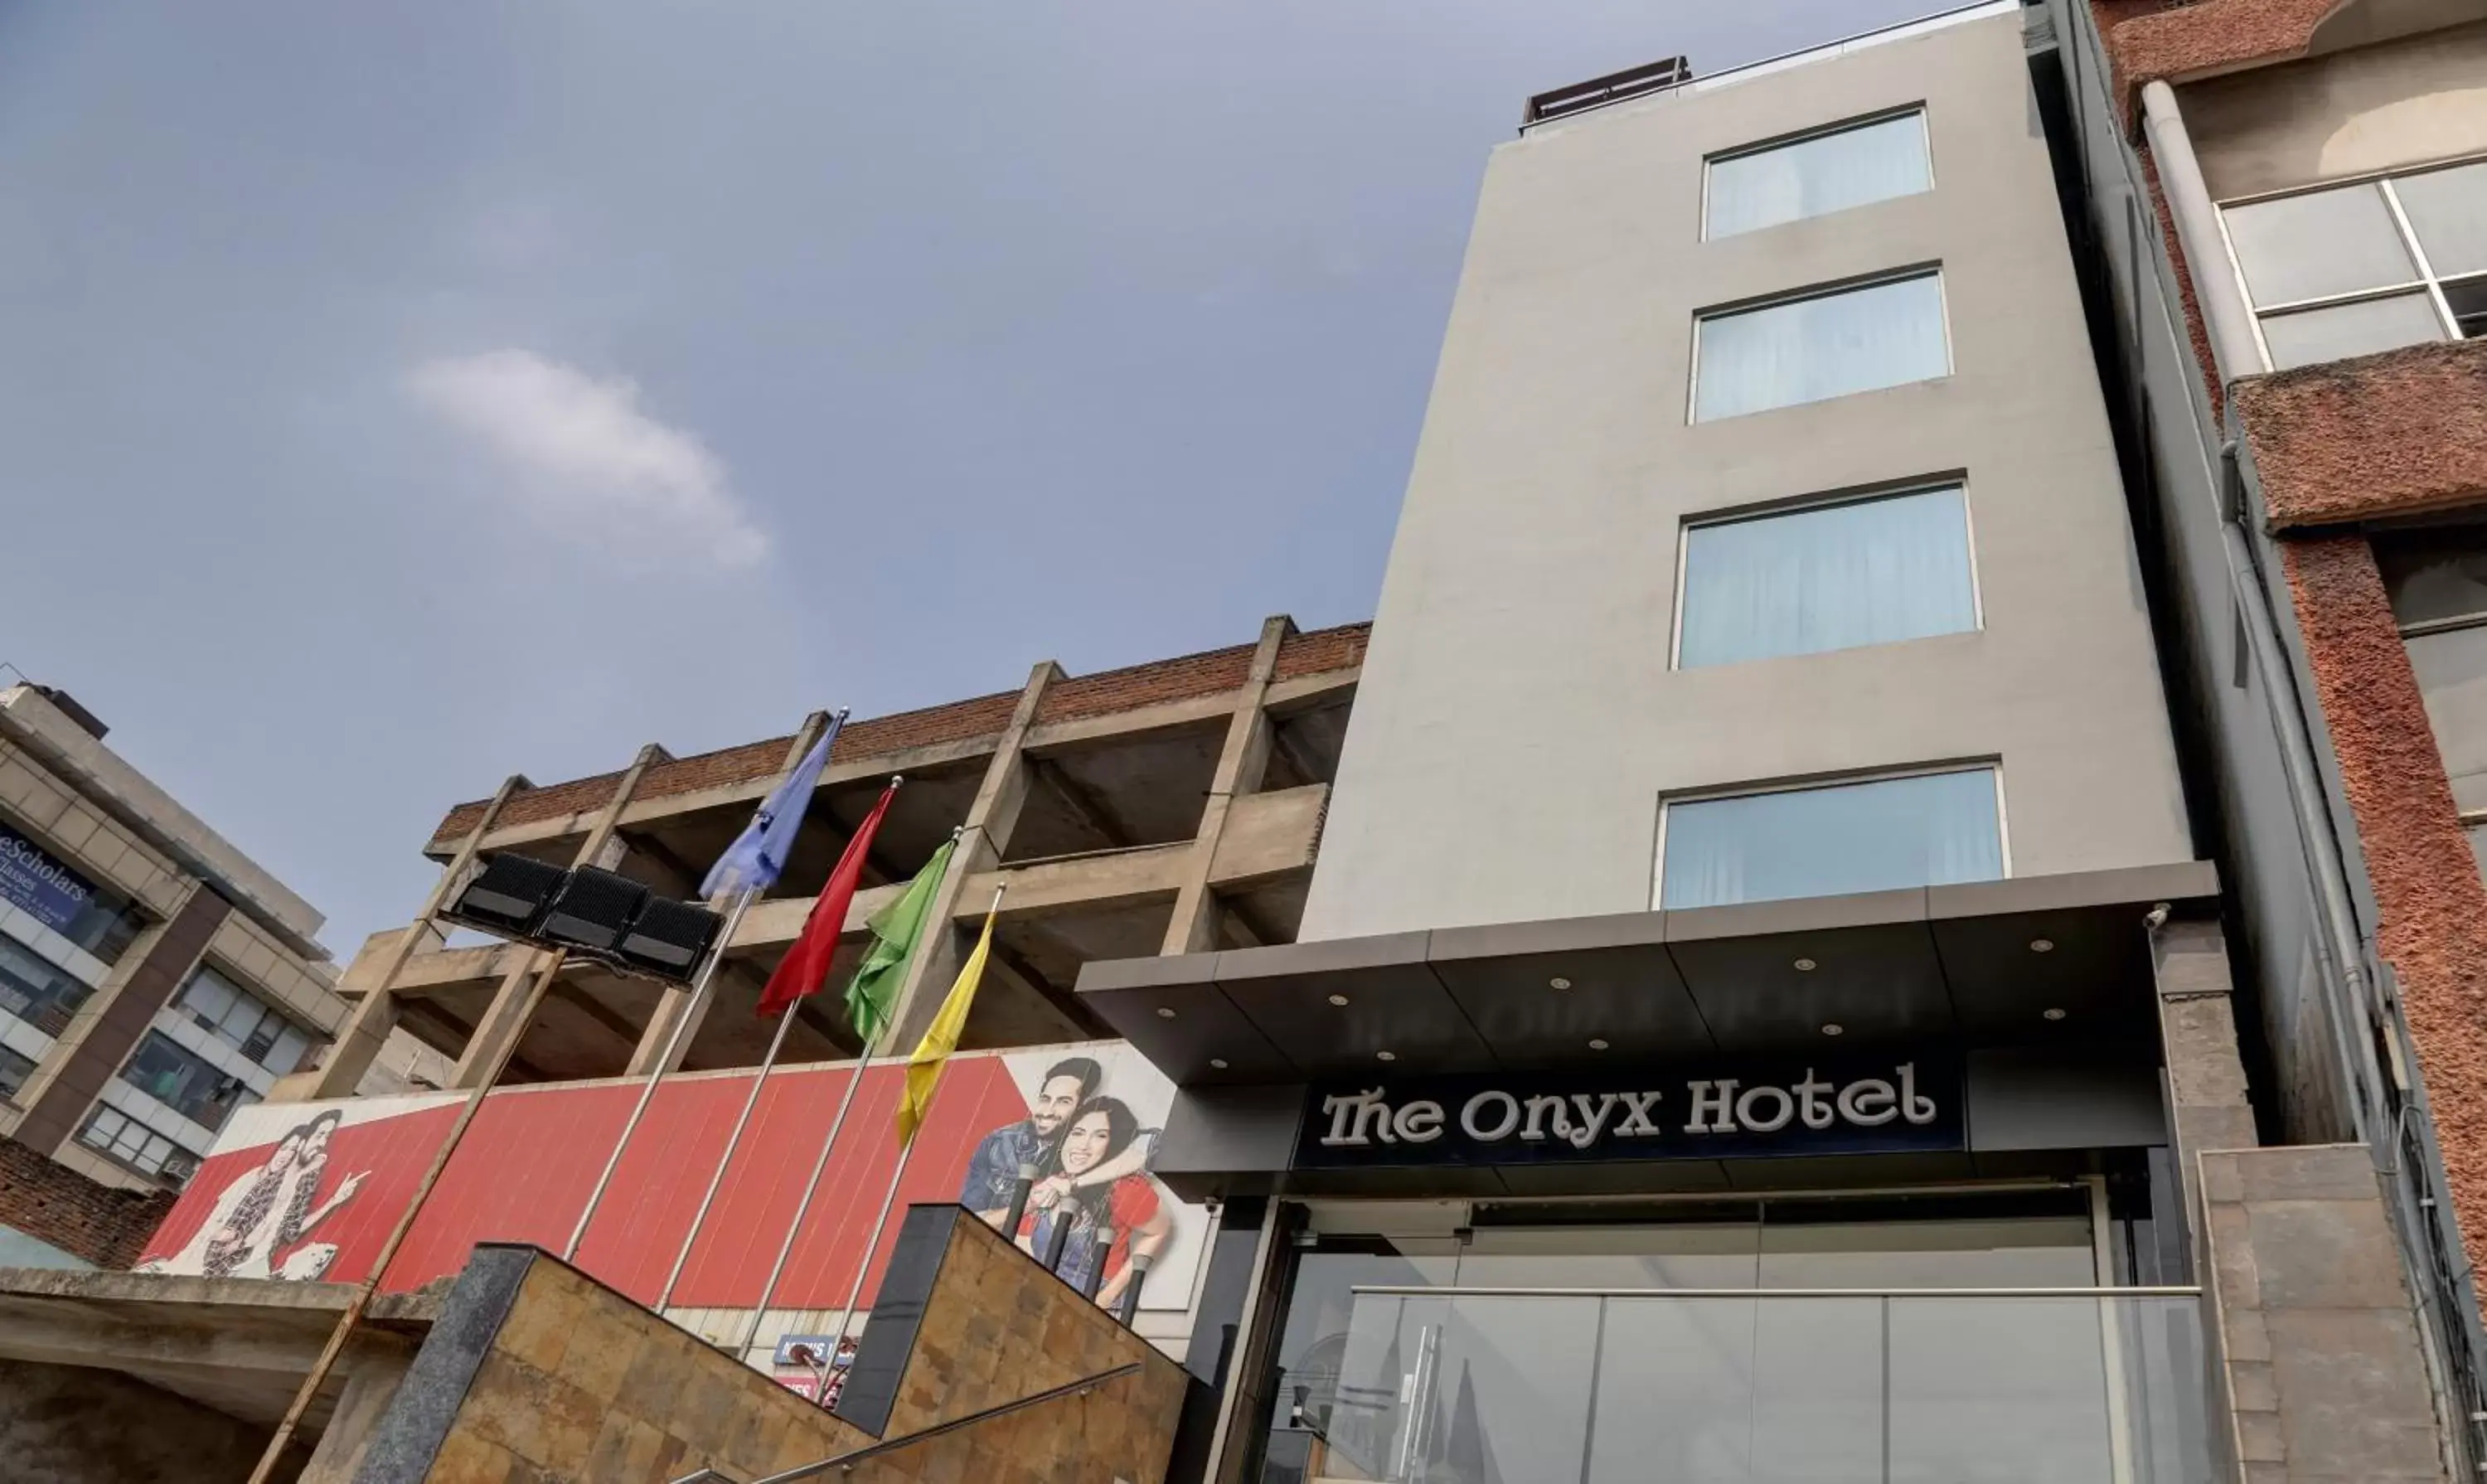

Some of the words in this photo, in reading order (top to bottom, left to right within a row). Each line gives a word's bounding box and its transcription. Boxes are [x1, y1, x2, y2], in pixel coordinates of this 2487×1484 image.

[1321, 1086, 1446, 1146] The
[1461, 1089, 1662, 1148] Onyx
[1684, 1062, 1937, 1132] Hotel
